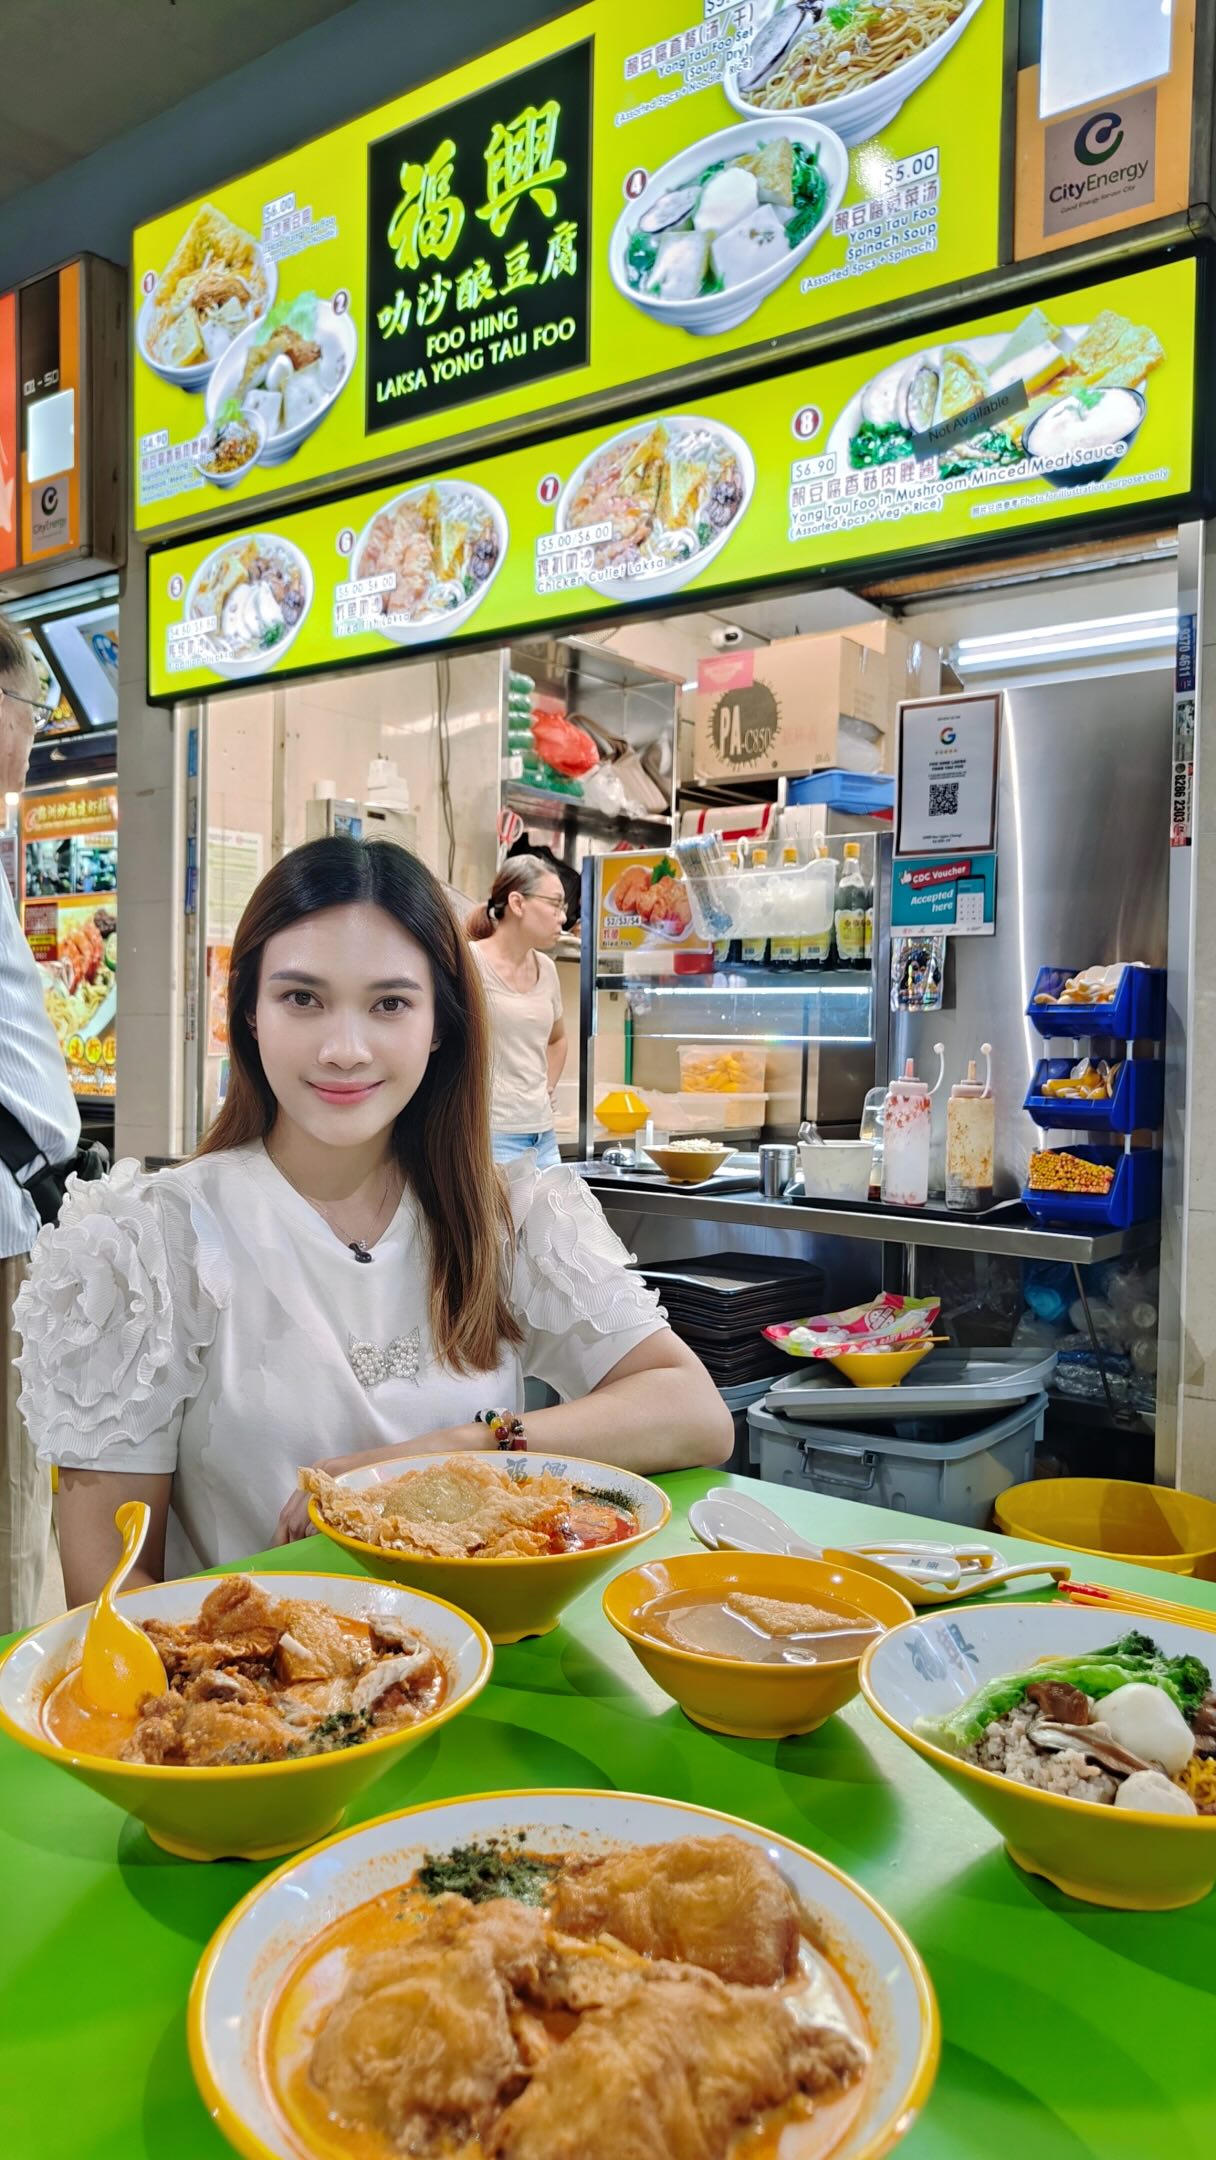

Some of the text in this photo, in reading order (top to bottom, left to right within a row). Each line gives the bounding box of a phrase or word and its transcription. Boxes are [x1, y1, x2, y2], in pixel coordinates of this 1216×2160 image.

[658, 58, 686, 77] Yong
[689, 48, 709, 63] Tau
[712, 38, 732, 52] Foo
[387, 99, 567, 270] 福興
[884, 154, 935, 186] $5.00
[1049, 159, 1149, 203] CityEnergy
[848, 223, 936, 260] Spinach Soup
[849, 206, 937, 242] Yong Tau Foo
[800, 267, 849, 292] (Assorted
[889, 238, 937, 263] Spinach)
[426, 305, 519, 358] FOO HING
[376, 316, 576, 402] LAKSA YONG TAU FOO
[928, 395, 1010, 442] Not Available
[792, 441, 1126, 525] Yong Tau Foo in Mushroom Minced Meat Sauce
[796, 458, 834, 479] $6.90
[790, 519, 838, 540] (Assorted
[879, 508, 900, 521] Veg
[913, 498, 942, 512] Rice)
[537, 558, 664, 593] Chicken Cutlet Laksa
[1179, 654, 1191, 678] 4611
[1174, 774, 1186, 798] 8286
[1173, 799, 1185, 823] 2303
[912, 865, 967, 884] CDC Voucher
[910, 888, 954, 906] Accepted
[931, 901, 954, 913] here
